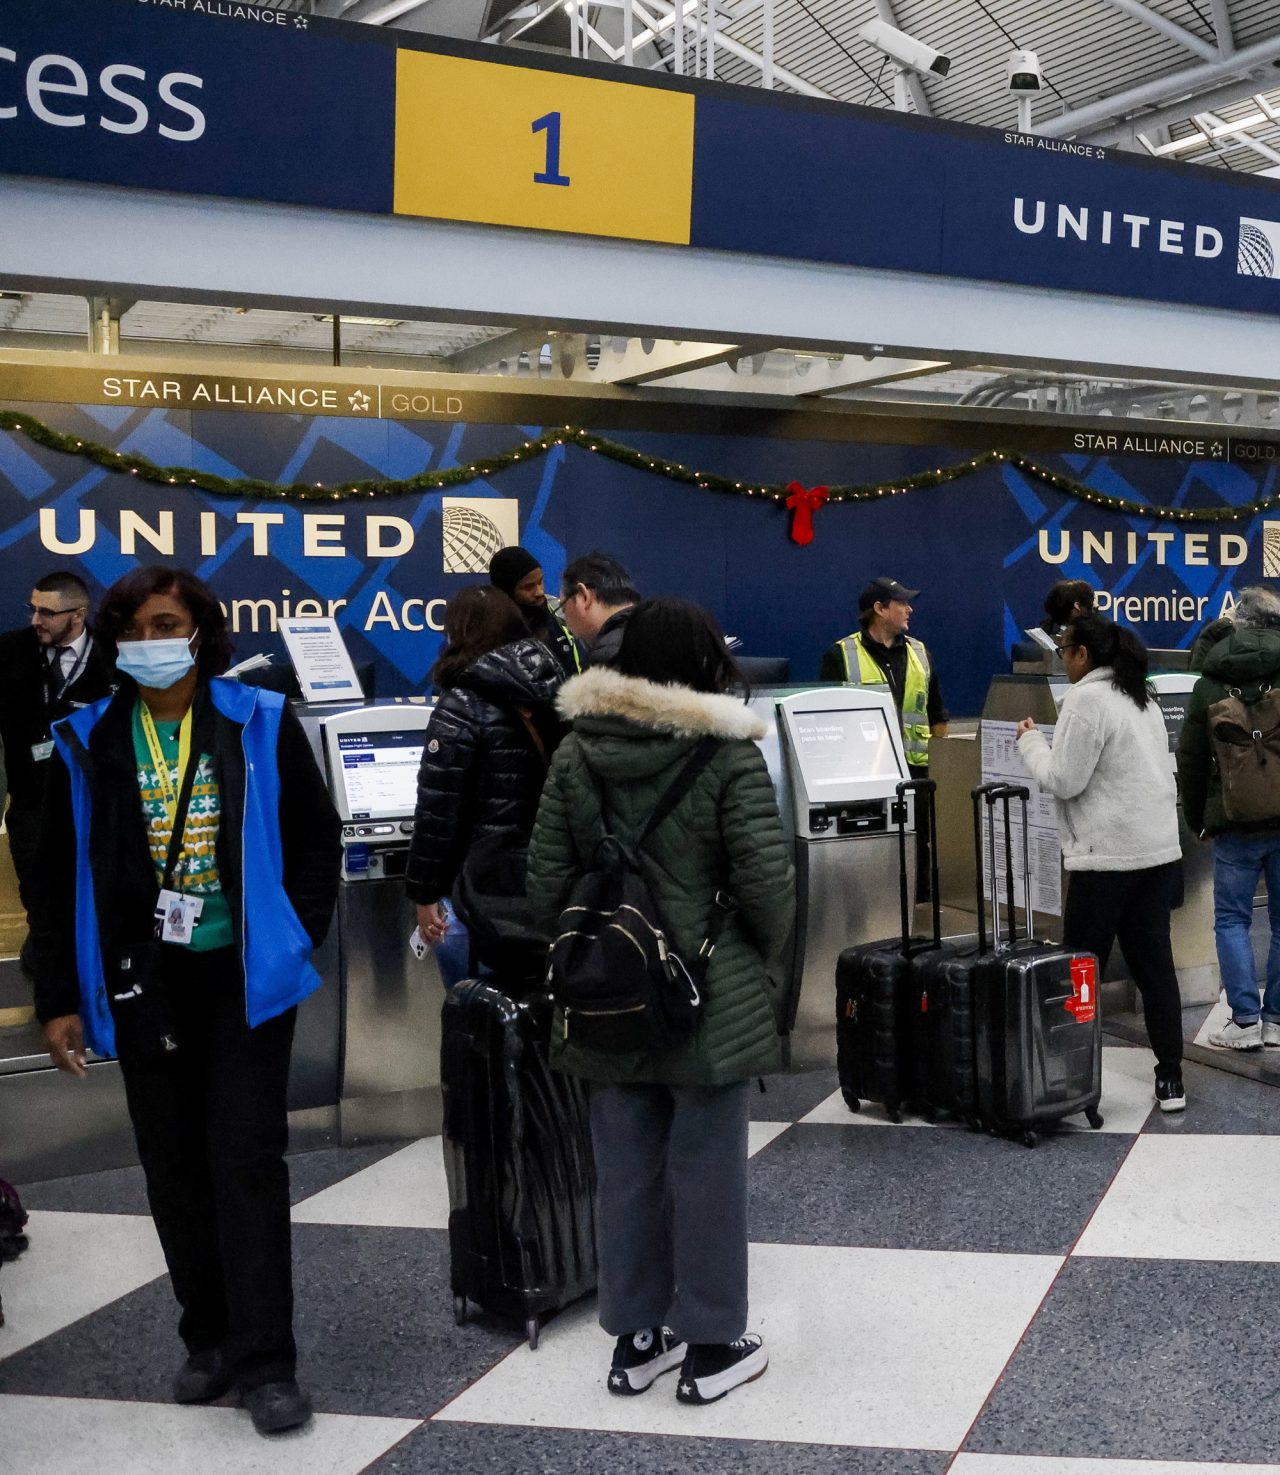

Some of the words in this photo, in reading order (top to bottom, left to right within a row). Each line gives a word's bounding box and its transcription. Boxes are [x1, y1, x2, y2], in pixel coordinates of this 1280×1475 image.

[193, 1, 288, 26] ALLIANCE
[530, 110, 571, 187] 1
[1004, 132, 1034, 147] STAR
[1037, 138, 1093, 157] ALLIANCE
[1013, 196, 1224, 259] UNITED
[102, 377, 181, 401] STAR
[192, 382, 338, 409] ALLIANCE
[391, 394, 463, 415] GOLD
[1074, 433, 1118, 450] STAR
[1123, 437, 1205, 455] ALLIANCE
[1234, 443, 1276, 459] GOLD
[38, 508, 415, 559] UNITED
[1038, 529, 1248, 566] UNITED
[220, 588, 347, 633] mier
[1093, 589, 1208, 622] Premier
